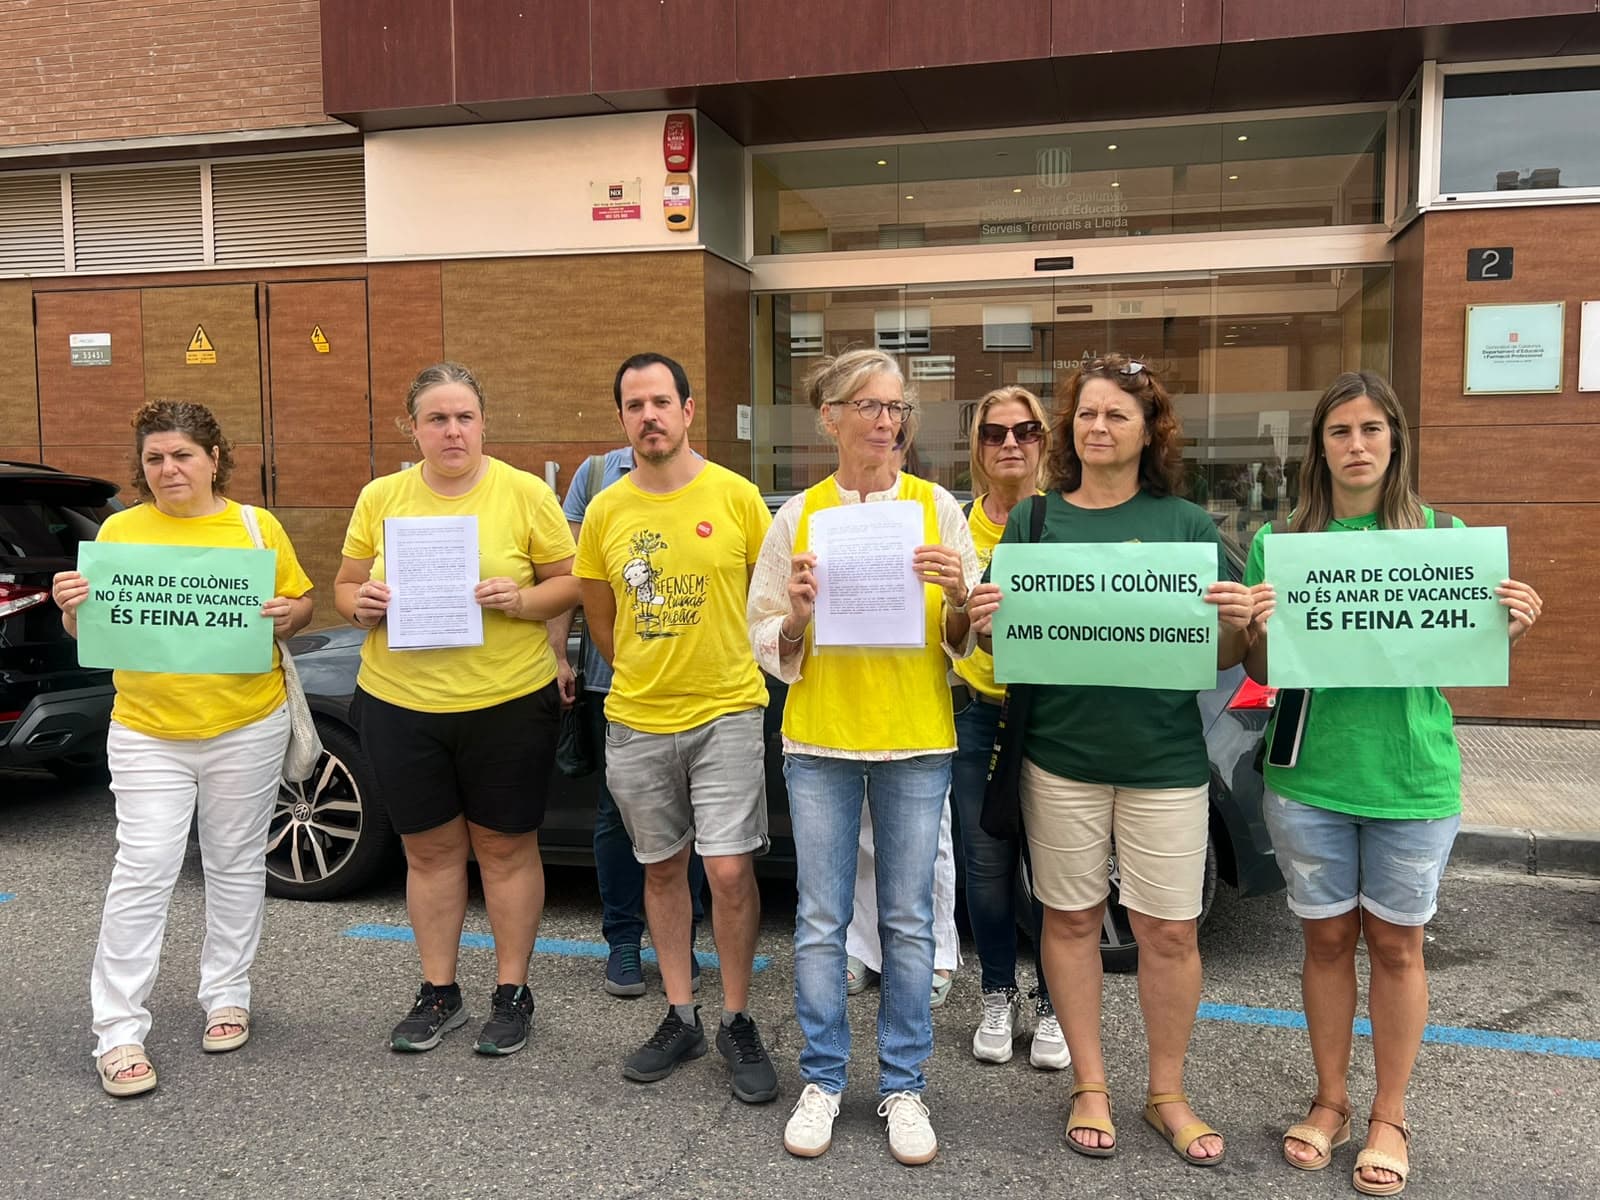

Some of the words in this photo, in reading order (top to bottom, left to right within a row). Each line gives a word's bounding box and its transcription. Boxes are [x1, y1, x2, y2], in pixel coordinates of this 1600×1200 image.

[982, 223, 1022, 235] Serveis
[1025, 220, 1081, 232] Territorials
[1084, 220, 1091, 228] a
[1095, 217, 1128, 228] Lleida
[1481, 250, 1500, 278] 2
[111, 574, 154, 587] ANAR
[158, 576, 176, 588] DE
[180, 575, 249, 590] COLÒNIES
[1011, 574, 1095, 592] SORTIDES
[1101, 574, 1105, 592] I
[1111, 569, 1202, 596] COLÒNIES,
[1306, 569, 1356, 583] ANAR
[1361, 568, 1383, 582] DE
[1388, 563, 1474, 582] COLÒNIES
[95, 590, 115, 602] NO
[119, 588, 132, 602] ÉS
[136, 591, 172, 603] ANAR
[176, 593, 192, 604] DE
[196, 594, 262, 607] VACANCES.
[1287, 590, 1310, 603] NO
[1315, 587, 1331, 603] ÉS
[1335, 589, 1379, 603] ANAR
[1384, 588, 1404, 602] DE
[1408, 587, 1492, 601] VACANCES.
[111, 604, 133, 624] ÉS
[140, 609, 199, 626] FEINA
[205, 611, 249, 628] 24H.
[1306, 607, 1333, 630] ÉS
[1342, 610, 1414, 630] FEINA
[1420, 609, 1476, 629] 24H.
[1006, 625, 1043, 640] AMB
[1049, 625, 1145, 642] CONDICIONS
[1150, 627, 1210, 643] DIGNES!
